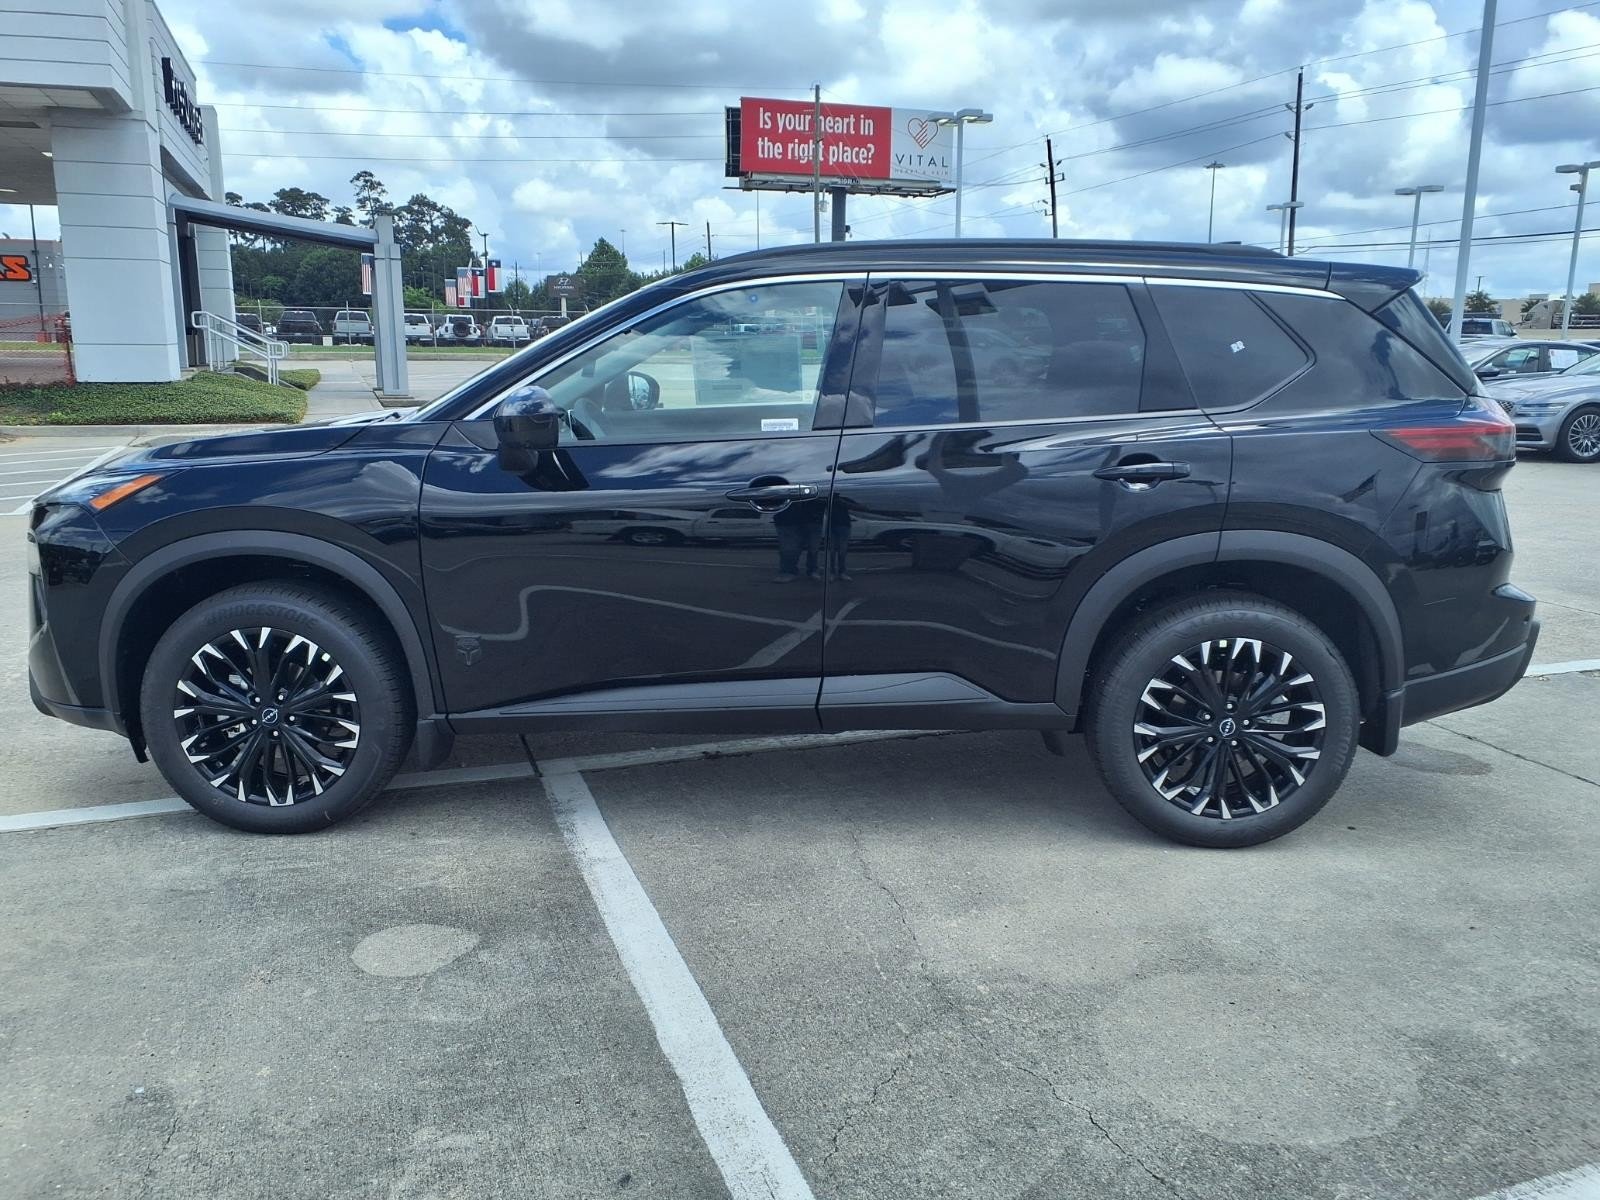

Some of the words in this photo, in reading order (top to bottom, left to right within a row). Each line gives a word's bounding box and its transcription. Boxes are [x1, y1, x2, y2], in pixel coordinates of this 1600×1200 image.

[759, 107, 772, 129] Is
[776, 112, 812, 134] your
[860, 114, 874, 136] in
[757, 137, 783, 159] the
[787, 138, 824, 164] right
[829, 141, 875, 166] place?
[895, 153, 949, 168] VITAL
[0, 255, 32, 281] S
